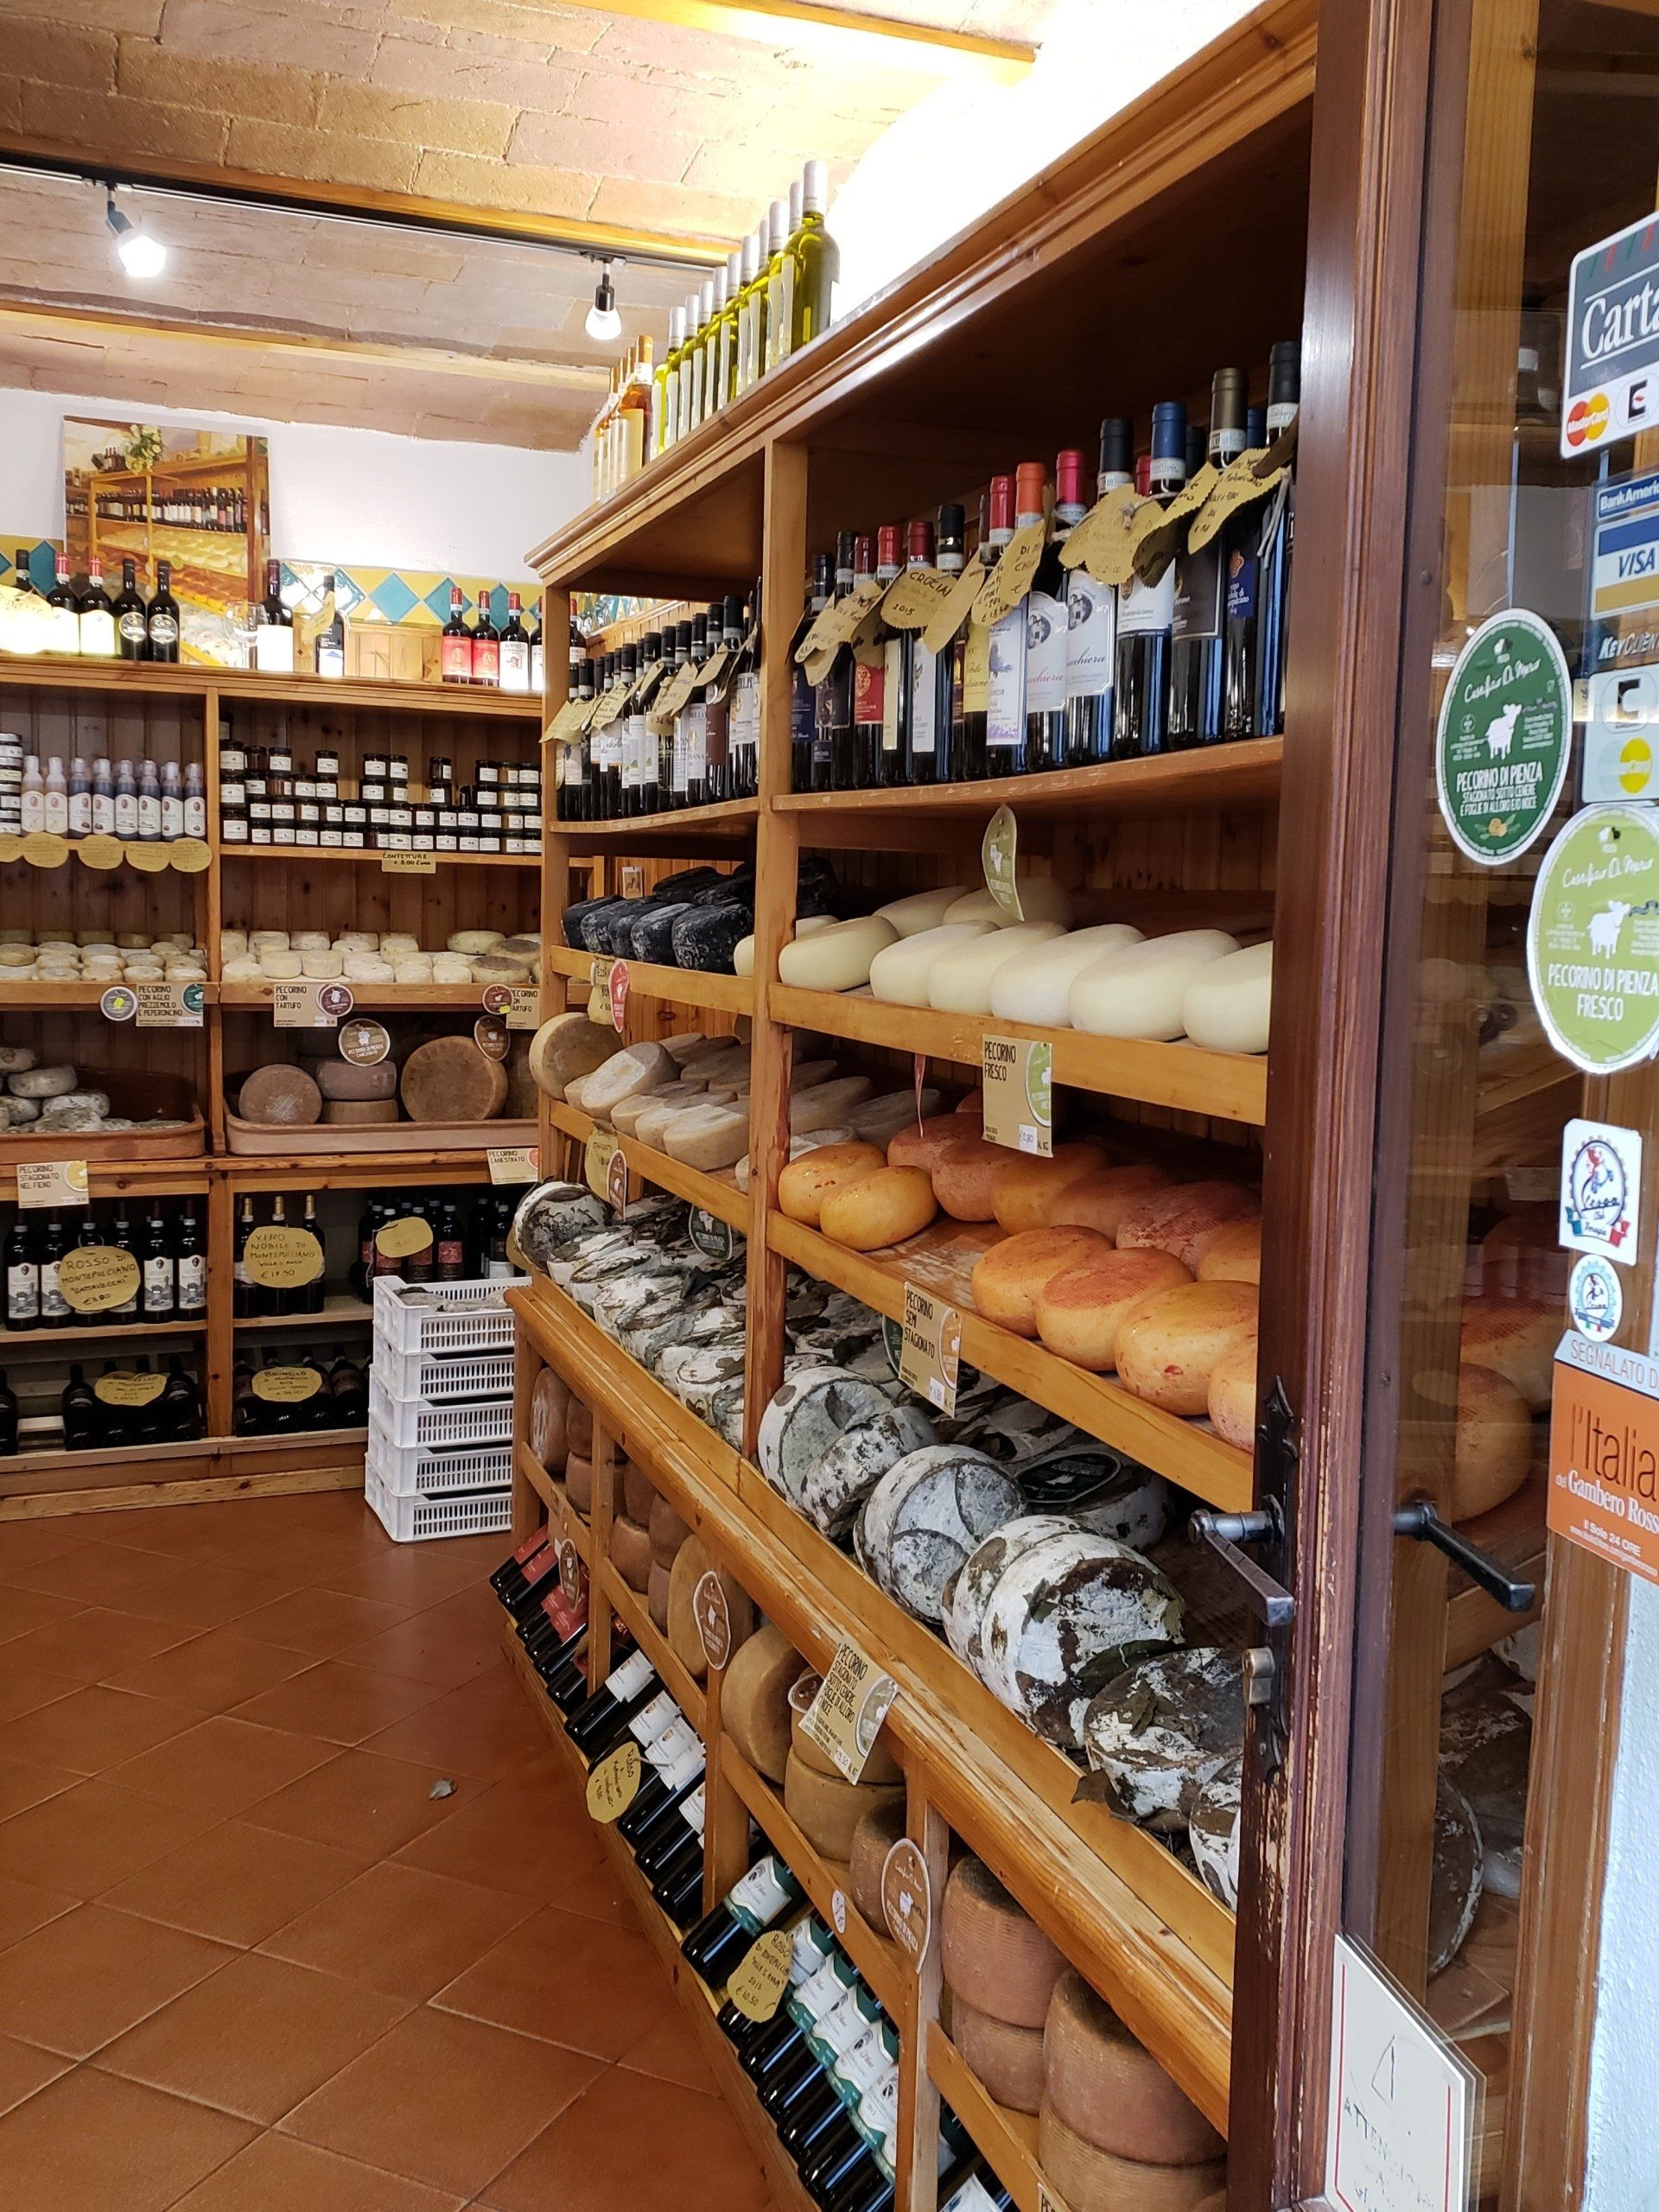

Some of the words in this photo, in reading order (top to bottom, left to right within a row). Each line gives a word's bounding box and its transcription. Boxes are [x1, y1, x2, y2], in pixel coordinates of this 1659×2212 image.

[1618, 546, 1656, 579] VISA
[1457, 767, 1499, 793] PECORINO
[1500, 766, 1510, 786] DI
[1510, 761, 1543, 785] PIENZA
[138, 985, 172, 994] PECORINO
[276, 985, 307, 994] PECORINO
[1548, 963, 1602, 991] PECORINO
[1603, 967, 1614, 992] DI
[1616, 968, 1659, 997] PIENZA
[1576, 994, 1624, 1022] FRESCO
[984, 1040, 1016, 1064] PECORINO
[984, 1062, 1007, 1082] FRESCO
[19, 1165, 53, 1174] PECORINO
[20, 1173, 60, 1182] STAGIONATO
[61, 1263, 136, 1283] MONTEPULCIANO
[67, 1256, 110, 1270] ROSSO
[906, 1288, 934, 1320] PECORINO
[905, 1309, 917, 1328] SEMI
[904, 1327, 935, 1359] STAGIONATO
[1571, 1339, 1645, 1384] SEGNALATO
[1555, 1472, 1567, 1489] del
[1567, 1469, 1625, 1517] Gambero
[1590, 1522, 1608, 1541] Sole
[1609, 1531, 1621, 1547] 24
[1621, 1538, 1642, 1557] ORE
[832, 1660, 858, 1690] STAGIONATO
[837, 1643, 868, 1681] PECORINO
[827, 1671, 840, 1692] SOTTO
[840, 1685, 856, 1707] CENERE
[838, 1701, 855, 1724] ALLORO
[771, 1934, 790, 1958] ROSSO
